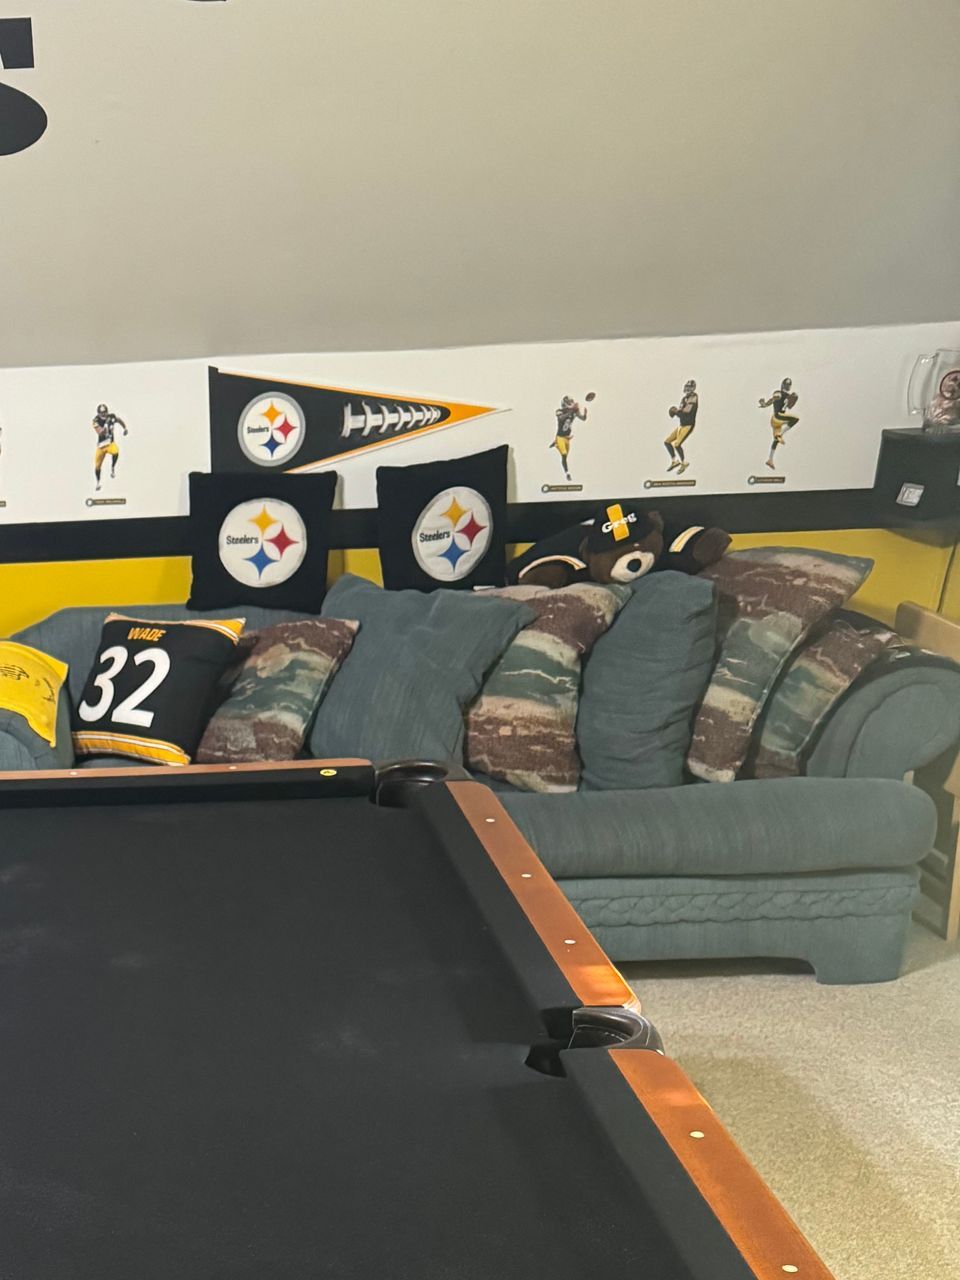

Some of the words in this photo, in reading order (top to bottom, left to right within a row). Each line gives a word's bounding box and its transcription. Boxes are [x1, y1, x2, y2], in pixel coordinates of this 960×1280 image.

[246, 424, 270, 435] Steelers
[601, 512, 638, 534] Greg
[225, 534, 259, 545] Steelers
[419, 530, 451, 543] Steelers
[126, 627, 165, 642] WADE
[79, 645, 172, 728] 32
